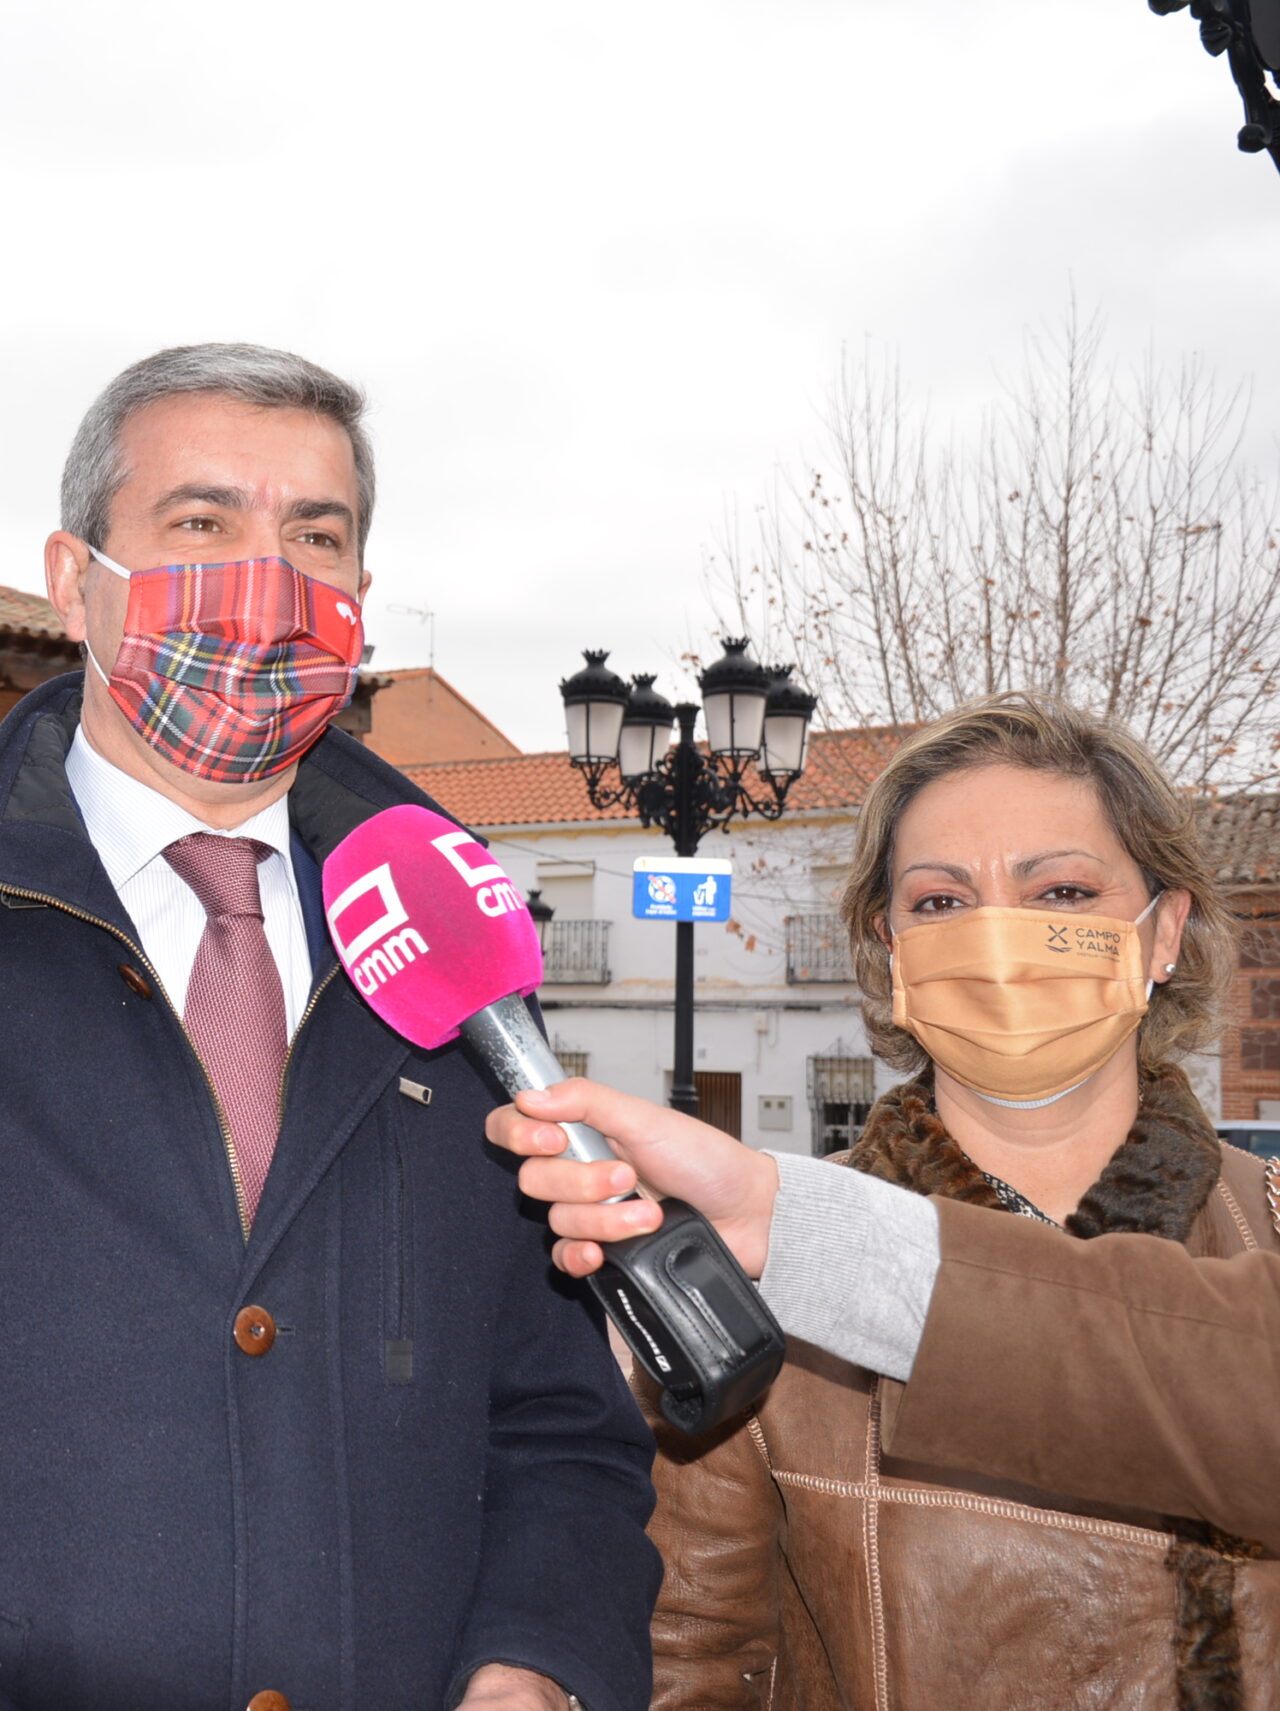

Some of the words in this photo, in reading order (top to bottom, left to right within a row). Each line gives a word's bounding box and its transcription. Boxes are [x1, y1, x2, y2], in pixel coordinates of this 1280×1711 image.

[476, 882, 522, 917] cm
[1075, 928, 1120, 943] CAMPO
[353, 927, 429, 995] cmm
